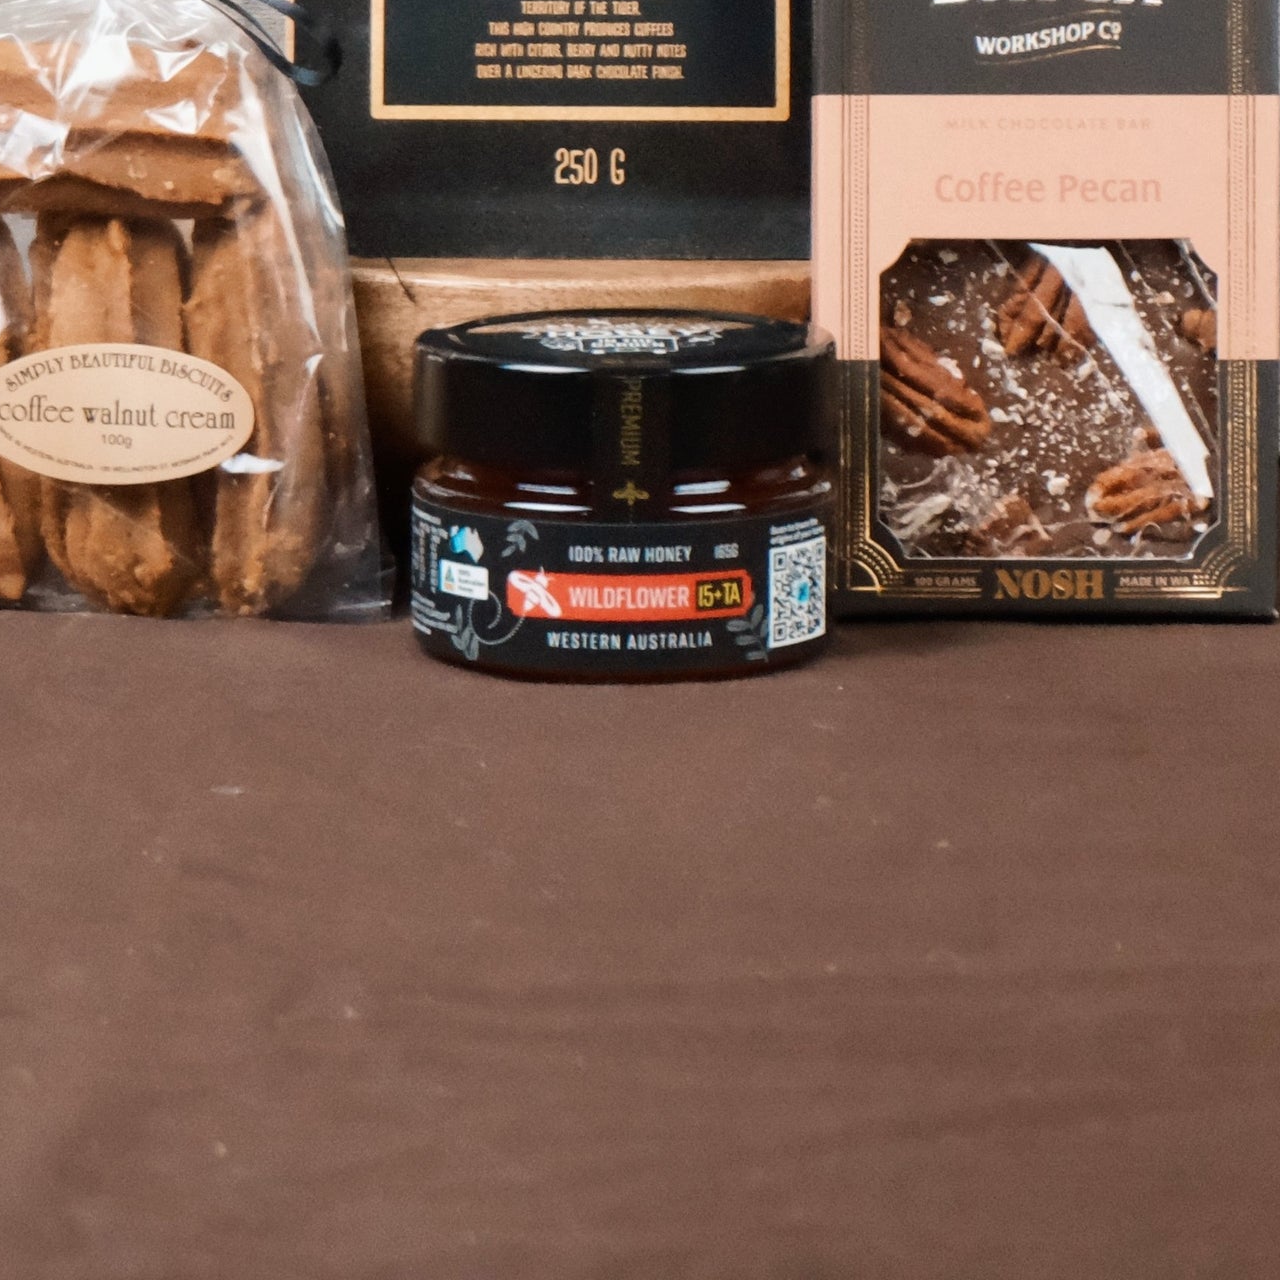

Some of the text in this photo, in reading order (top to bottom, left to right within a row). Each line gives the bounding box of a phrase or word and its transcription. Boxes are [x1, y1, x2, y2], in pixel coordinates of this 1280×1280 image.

[574, 0, 586, 15] OF
[589, 0, 608, 15] THE
[975, 21, 1096, 55] WORKSHOP
[599, 43, 620, 58] AND
[504, 64, 513, 79] A
[554, 147, 626, 185] 250 G
[934, 172, 1162, 202] Coffee Pecan
[5, 352, 234, 402] SIMPLY BEAUTIFUL BISCUITS
[82, 400, 158, 427] walnut
[165, 410, 235, 430] cream
[621, 379, 642, 466] PREMIUM
[101, 434, 132, 448] 100g
[568, 545, 692, 563] 100% RAW HONEY
[993, 569, 1104, 600] NOSH
[1119, 576, 1153, 587] MADE
[1155, 576, 1168, 587] IN
[569, 586, 690, 609] WILDFLOWER
[546, 630, 713, 650] WESTERN AUSTRALIA
